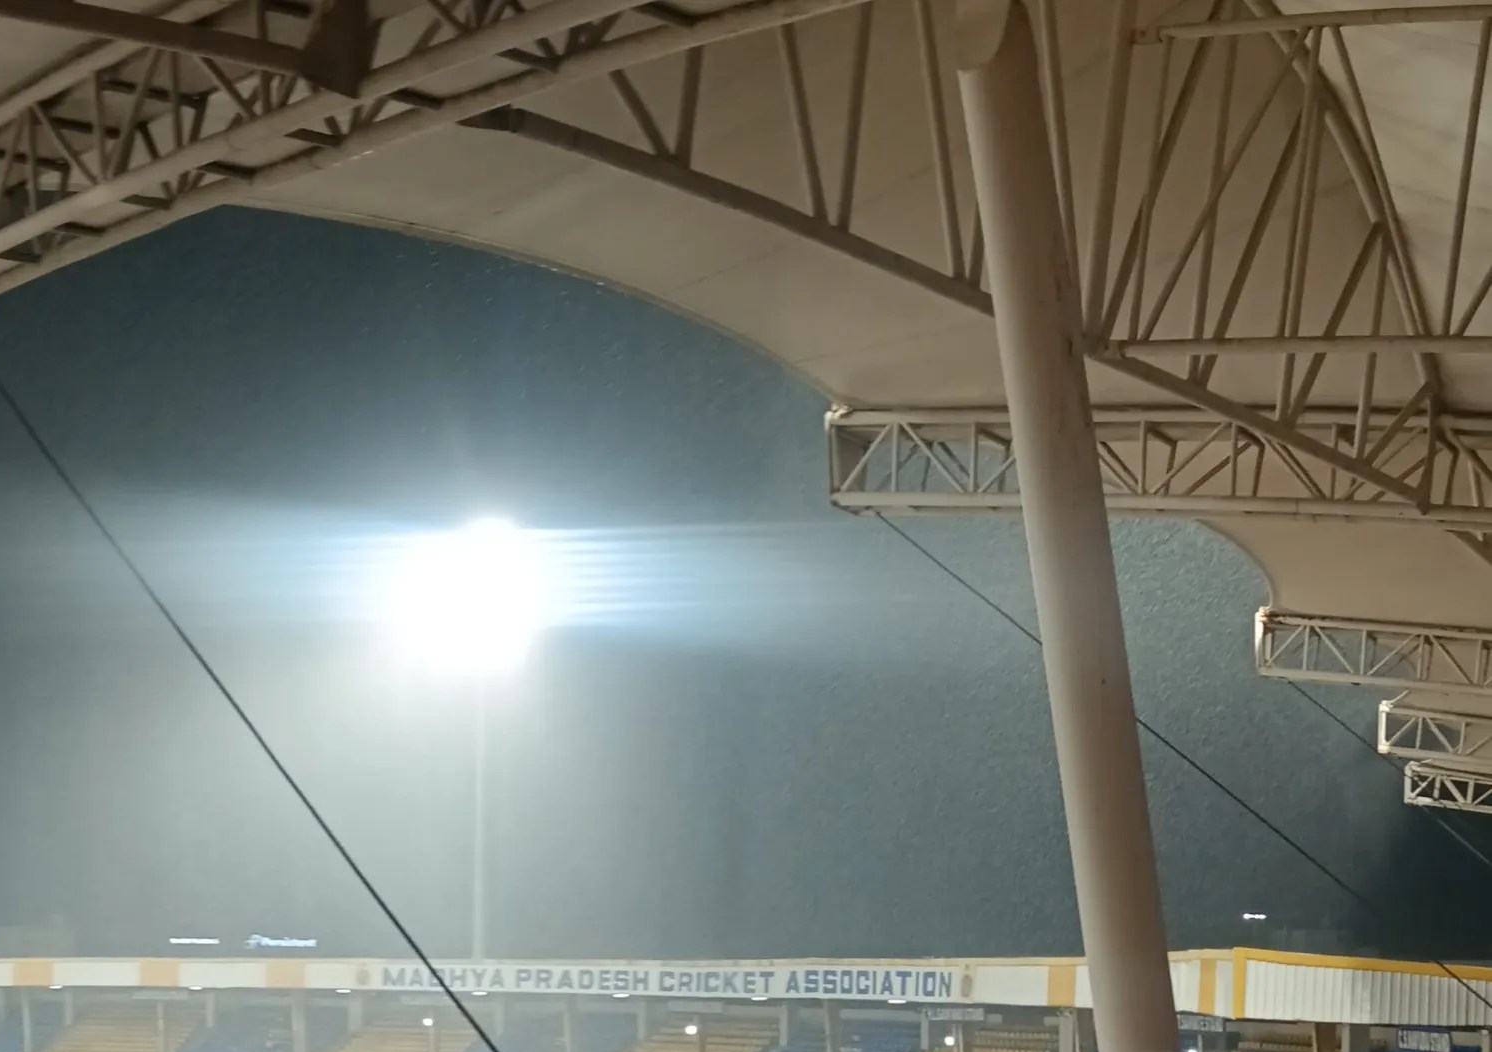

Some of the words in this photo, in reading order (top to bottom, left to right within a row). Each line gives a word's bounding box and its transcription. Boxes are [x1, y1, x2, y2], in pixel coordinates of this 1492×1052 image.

[515, 969, 649, 991] PRADESH
[658, 971, 775, 994] CRICKET
[785, 970, 953, 997] ASSOCIATION
